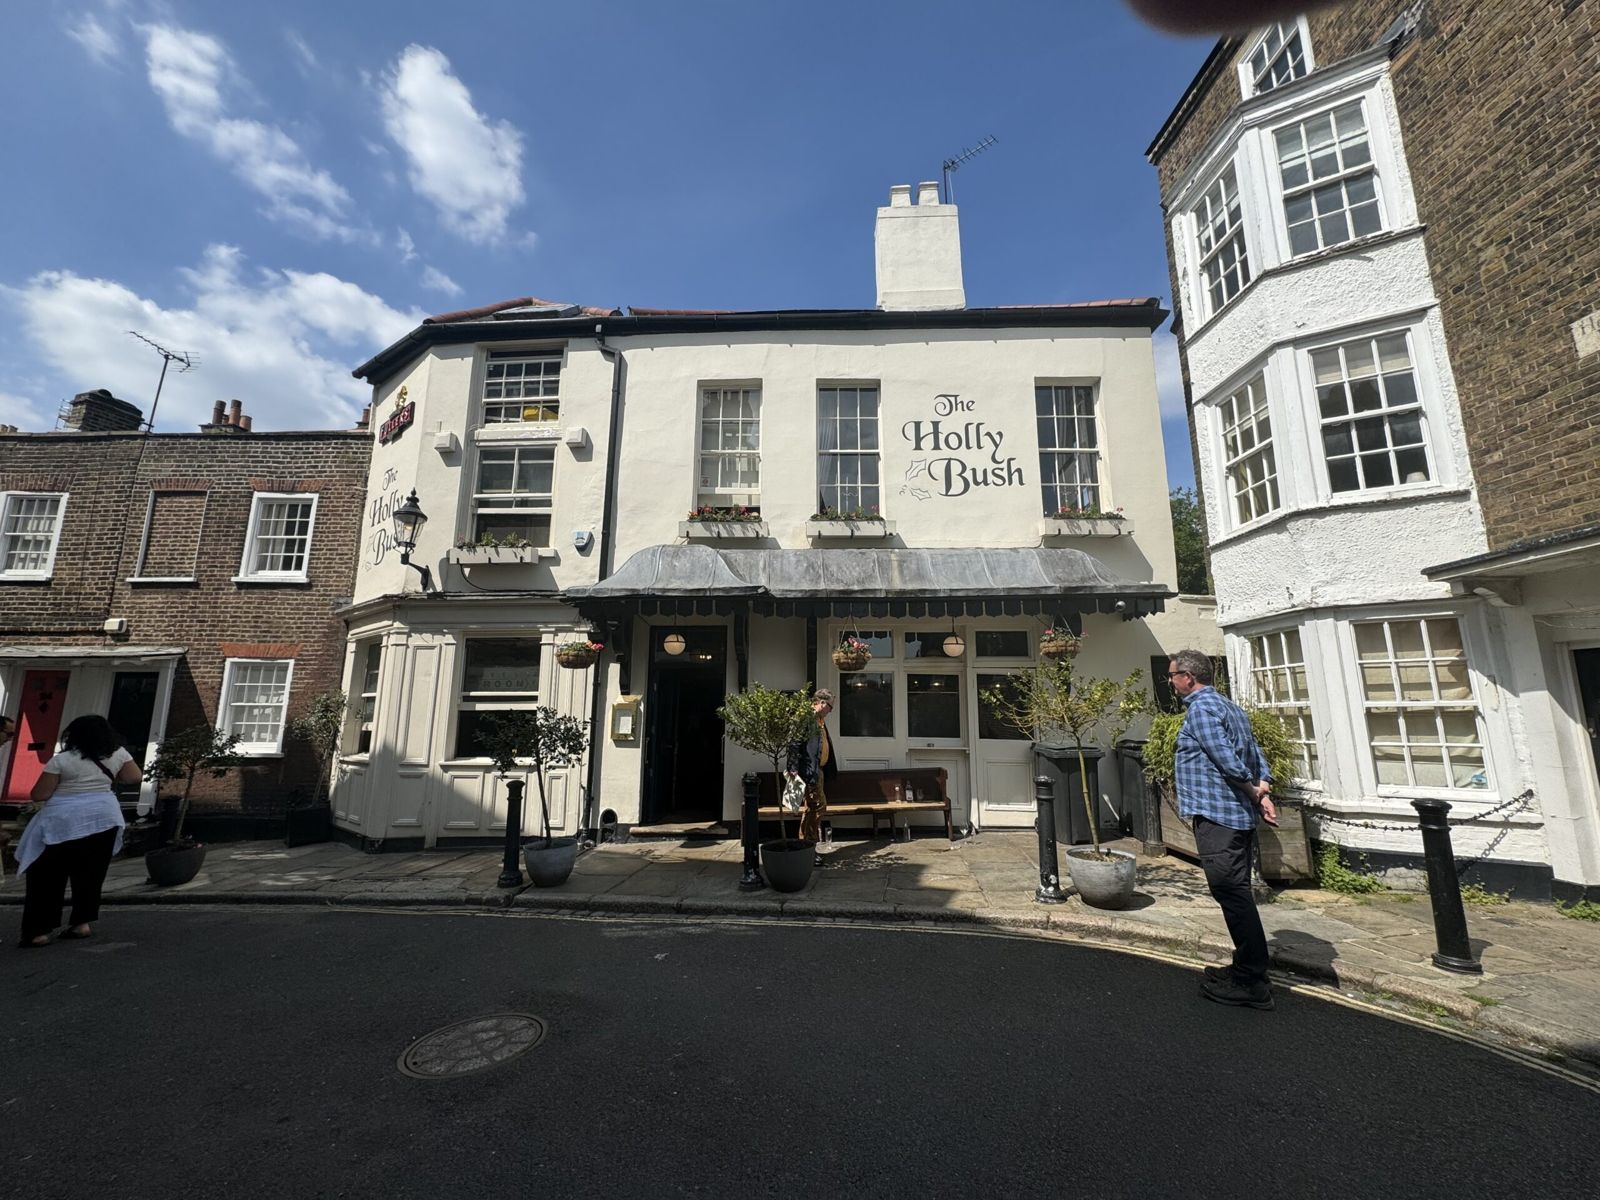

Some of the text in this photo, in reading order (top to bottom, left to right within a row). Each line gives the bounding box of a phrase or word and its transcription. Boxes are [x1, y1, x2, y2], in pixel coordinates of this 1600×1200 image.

[934, 394, 976, 417] The
[902, 420, 1005, 465] Holly
[382, 467, 398, 491] The
[927, 457, 1025, 497] Bush
